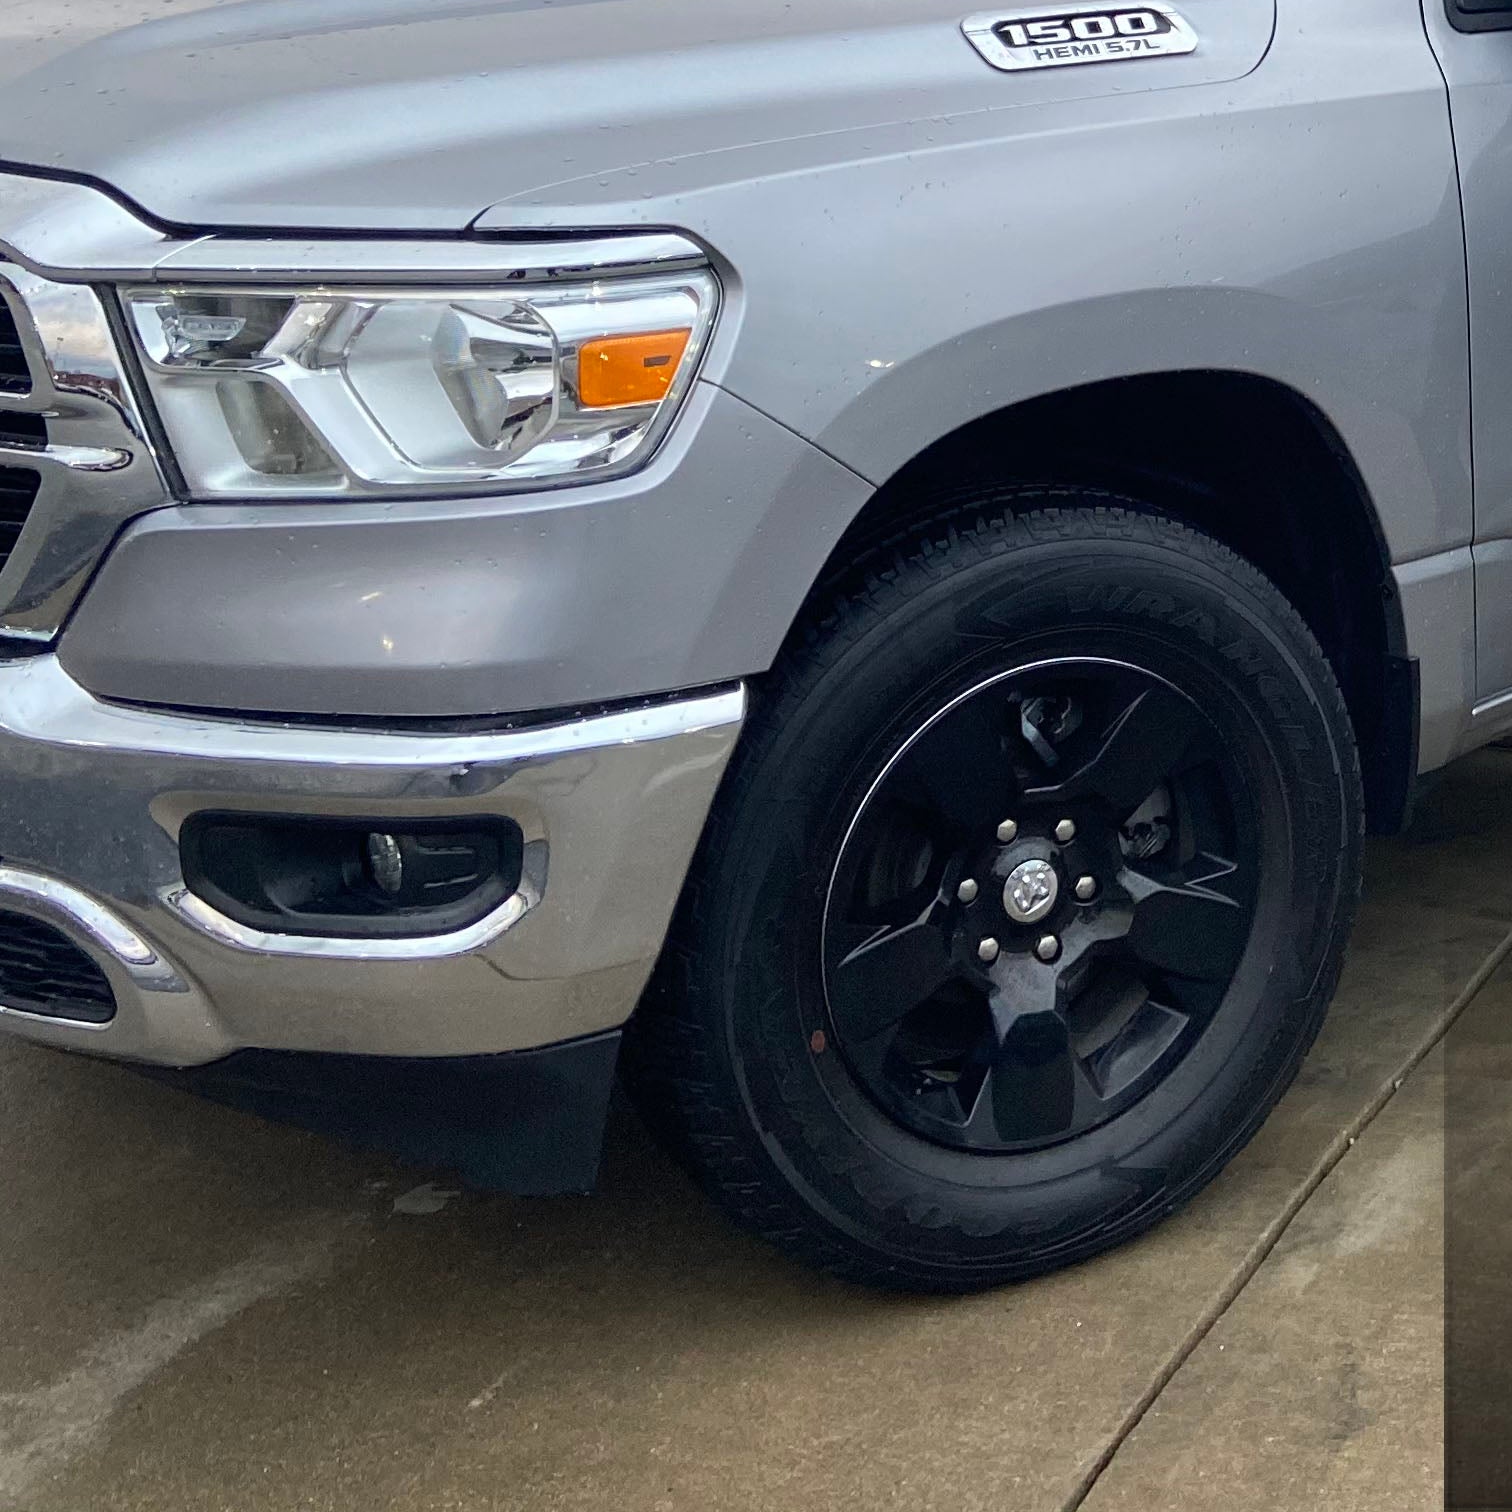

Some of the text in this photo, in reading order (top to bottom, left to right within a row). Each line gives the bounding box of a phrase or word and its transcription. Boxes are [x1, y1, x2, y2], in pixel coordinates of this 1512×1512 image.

[998, 11, 1158, 46] 1500
[1033, 38, 1161, 61] HEMI 5.7L
